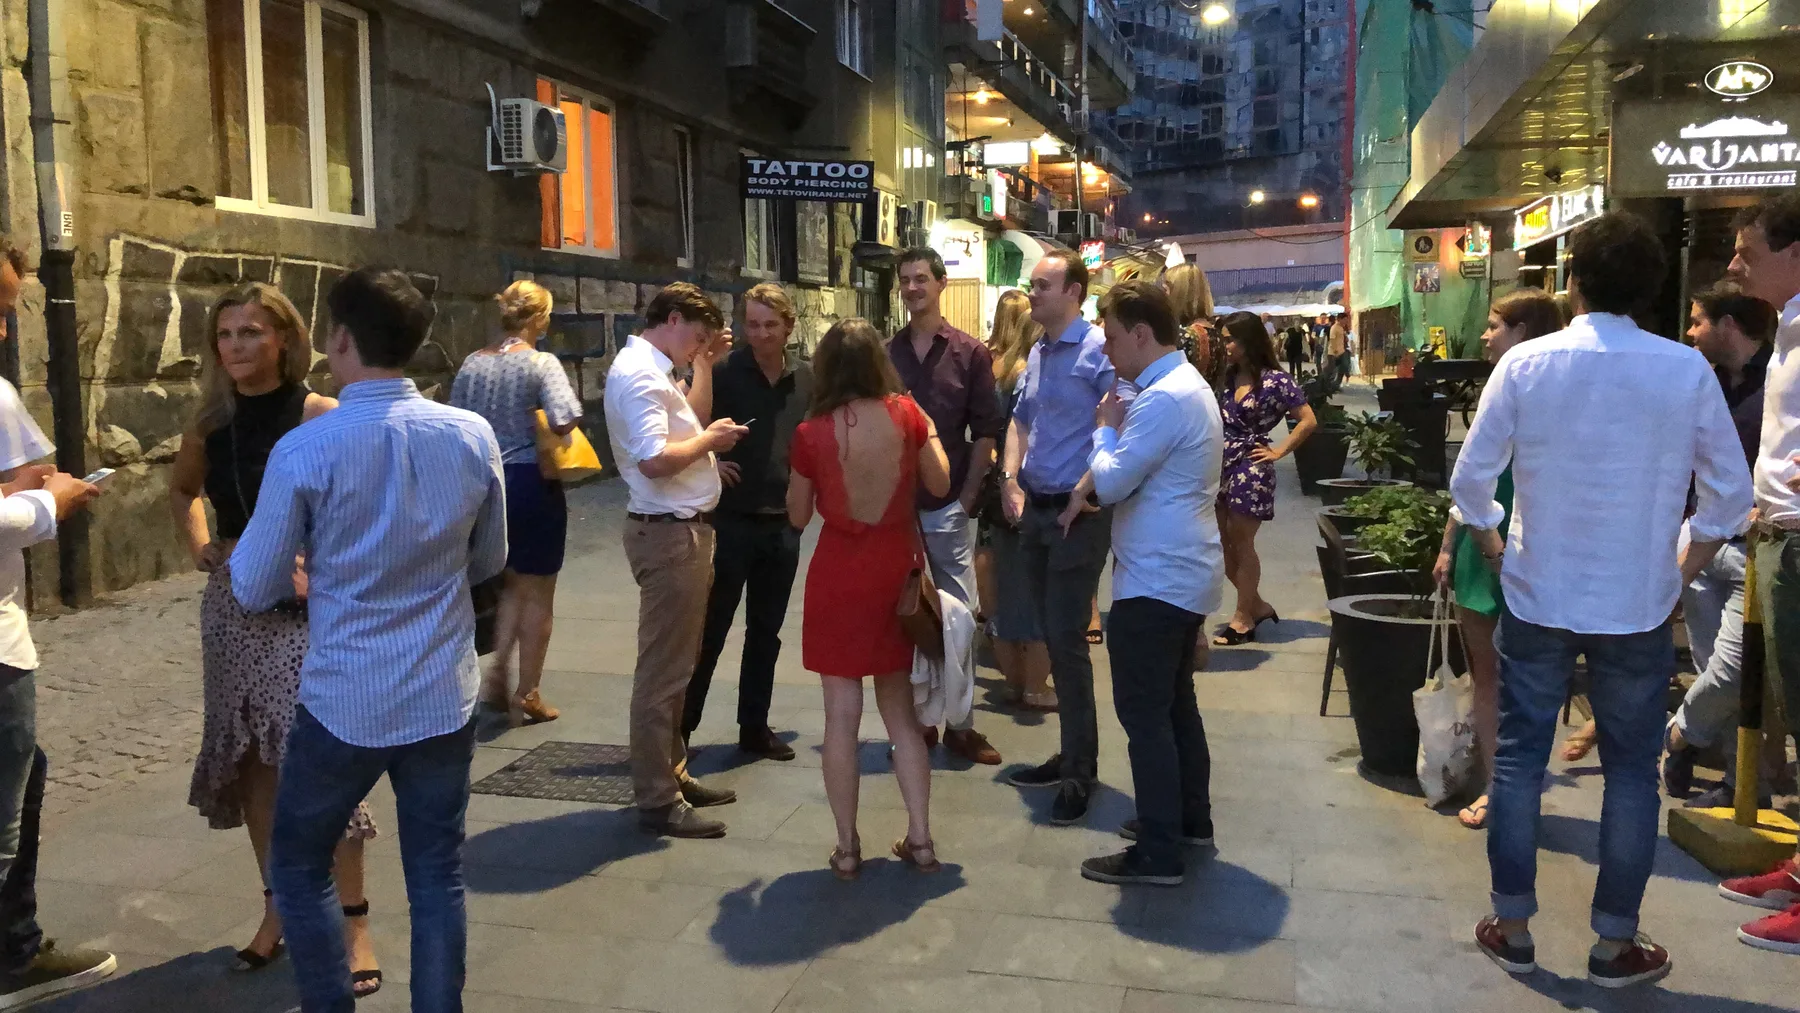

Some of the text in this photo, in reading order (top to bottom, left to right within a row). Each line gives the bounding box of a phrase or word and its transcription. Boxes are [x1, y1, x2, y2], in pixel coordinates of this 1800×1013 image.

[1651, 139, 1800, 171] VARIJANT
[748, 160, 869, 179] TATTOO
[748, 177, 868, 189] BODY PIERCING
[1667, 172, 1797, 187] cafe & restaurant
[748, 188, 868, 199] WWW.TETOVIRANJE.NET
[63, 214, 72, 234] BNE
